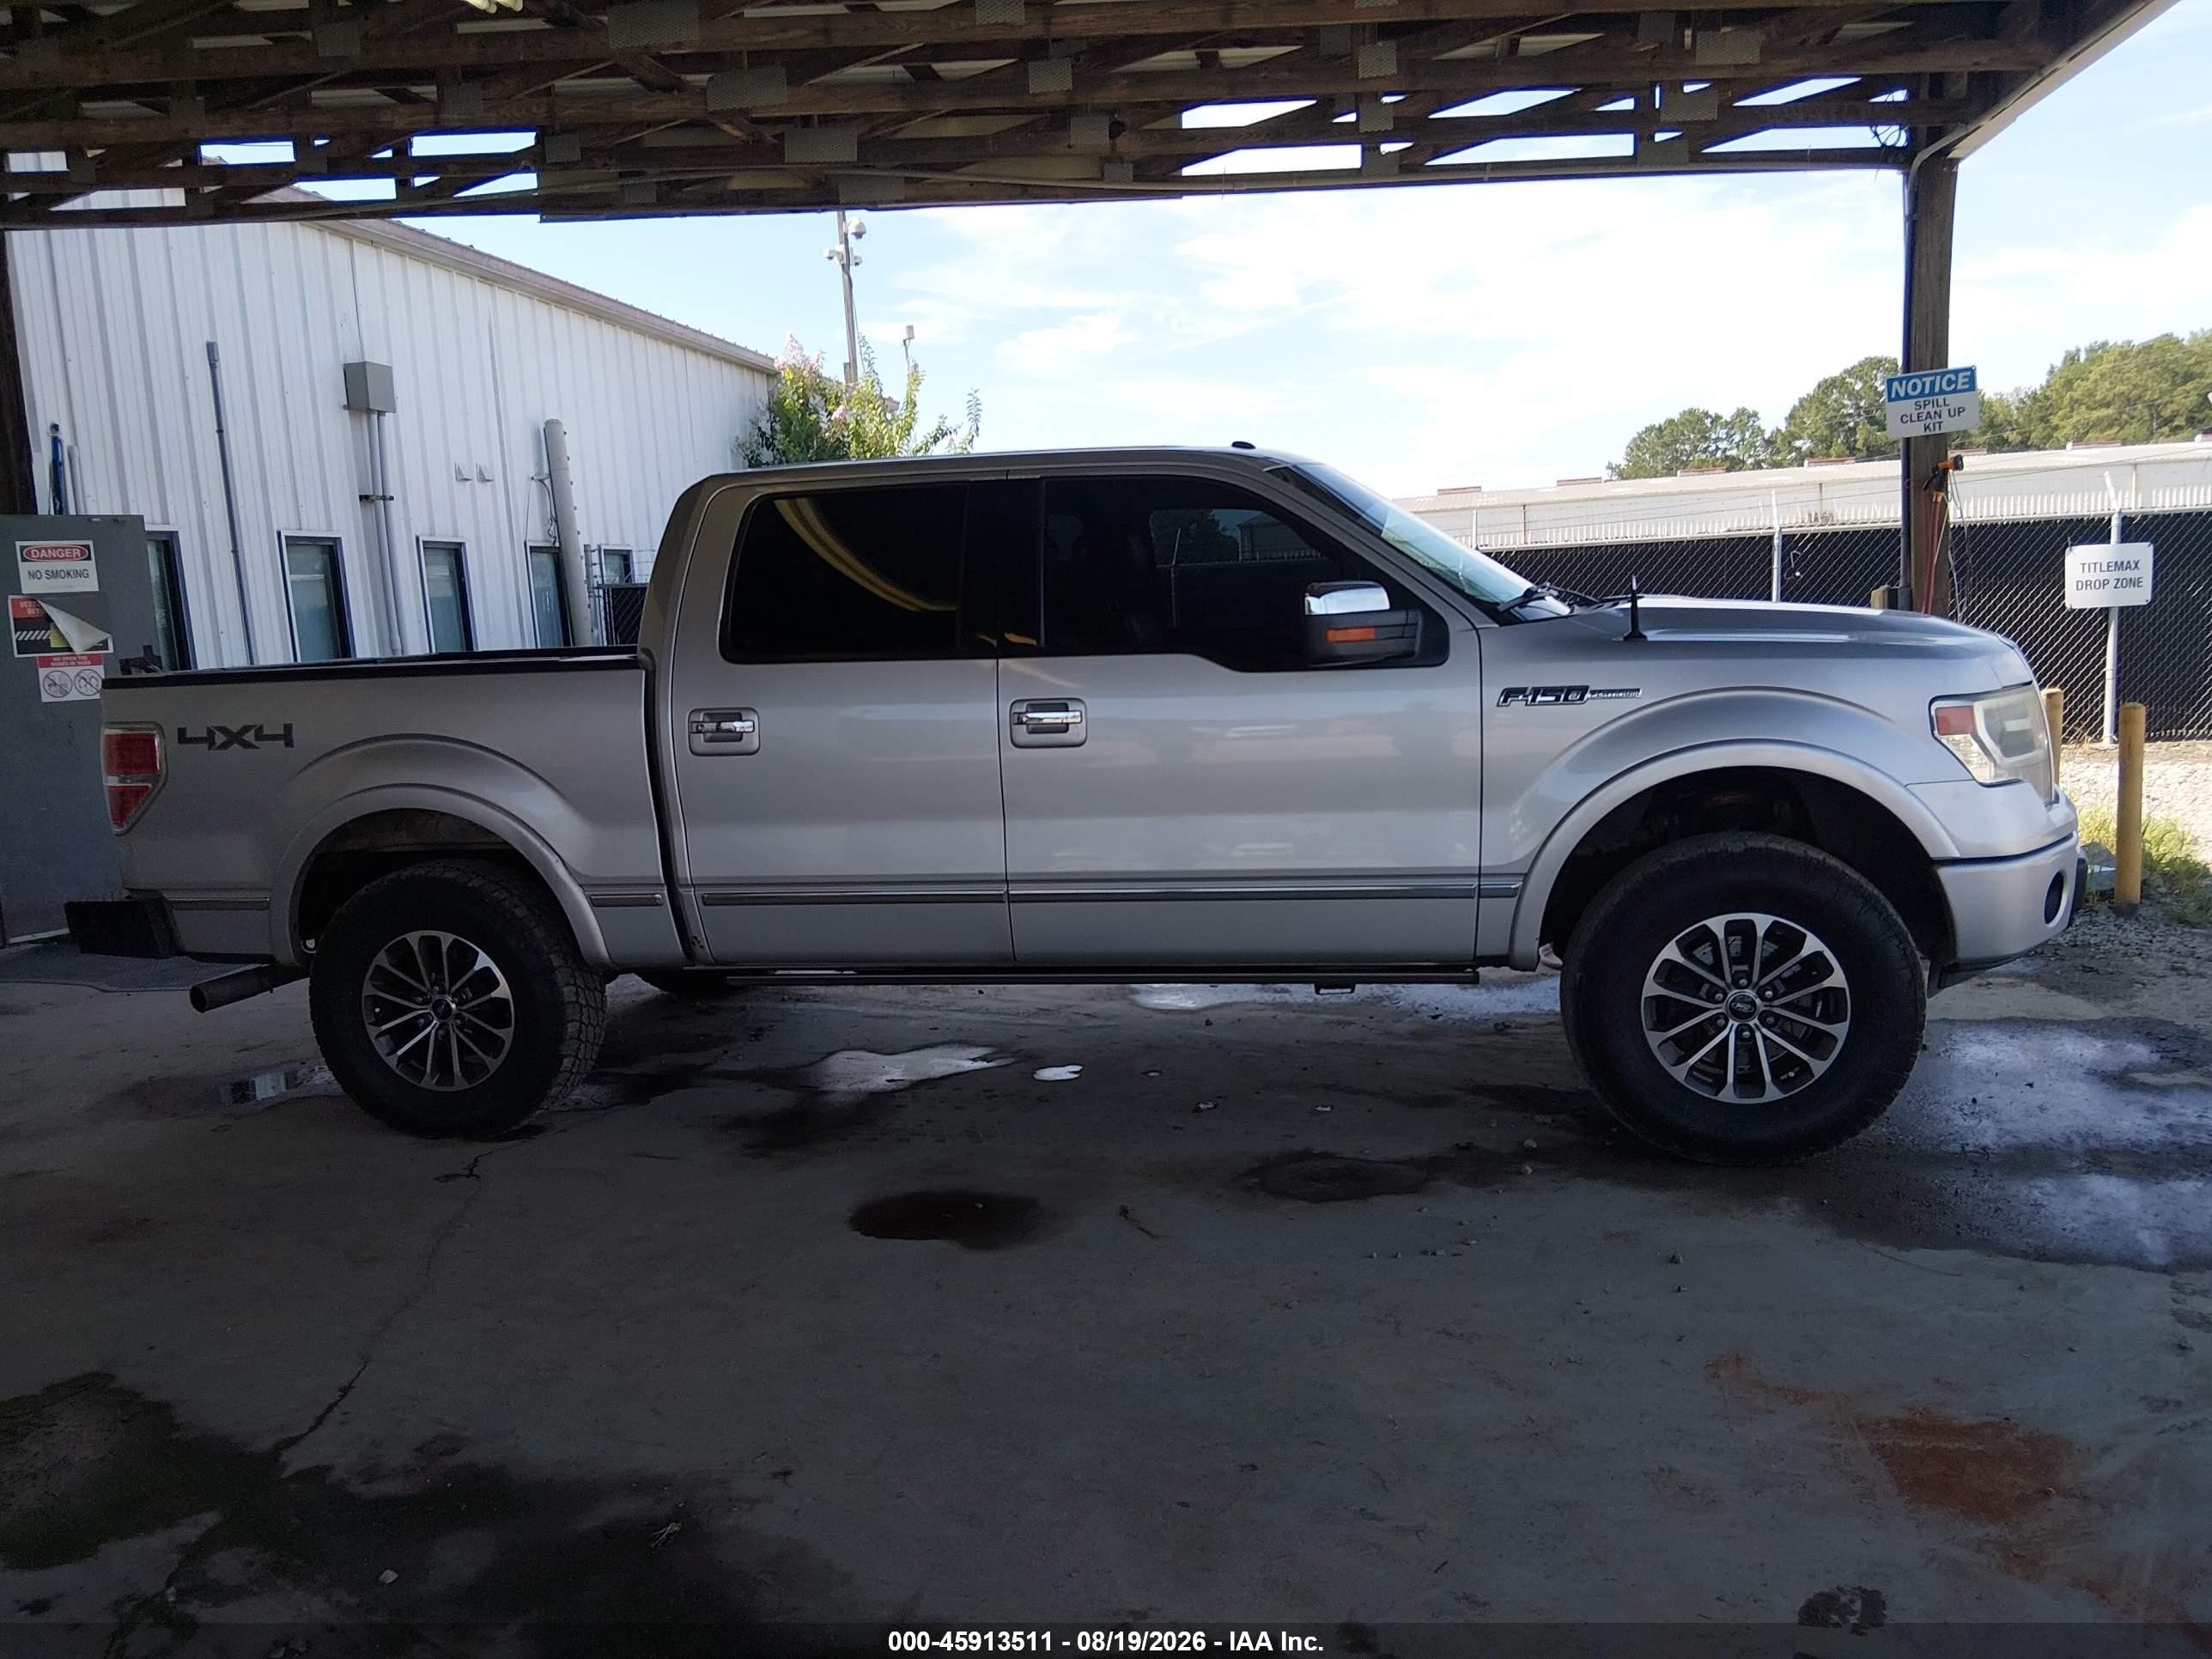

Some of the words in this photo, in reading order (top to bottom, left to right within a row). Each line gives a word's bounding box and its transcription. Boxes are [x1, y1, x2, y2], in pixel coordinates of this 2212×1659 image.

[1891, 372, 1972, 398] NOTICE
[1914, 398, 1950, 410] SPILL
[1900, 410, 1942, 424] CLEAN
[1948, 407, 1966, 418] UP
[1923, 421, 1944, 433] KIT
[30, 548, 82, 558] DANGER
[2080, 559, 2141, 573] TITLEMAX
[27, 569, 43, 580] NO
[45, 568, 89, 580] SMOKING
[2075, 579, 2110, 591] DROP
[2113, 576, 2143, 589] ZONE
